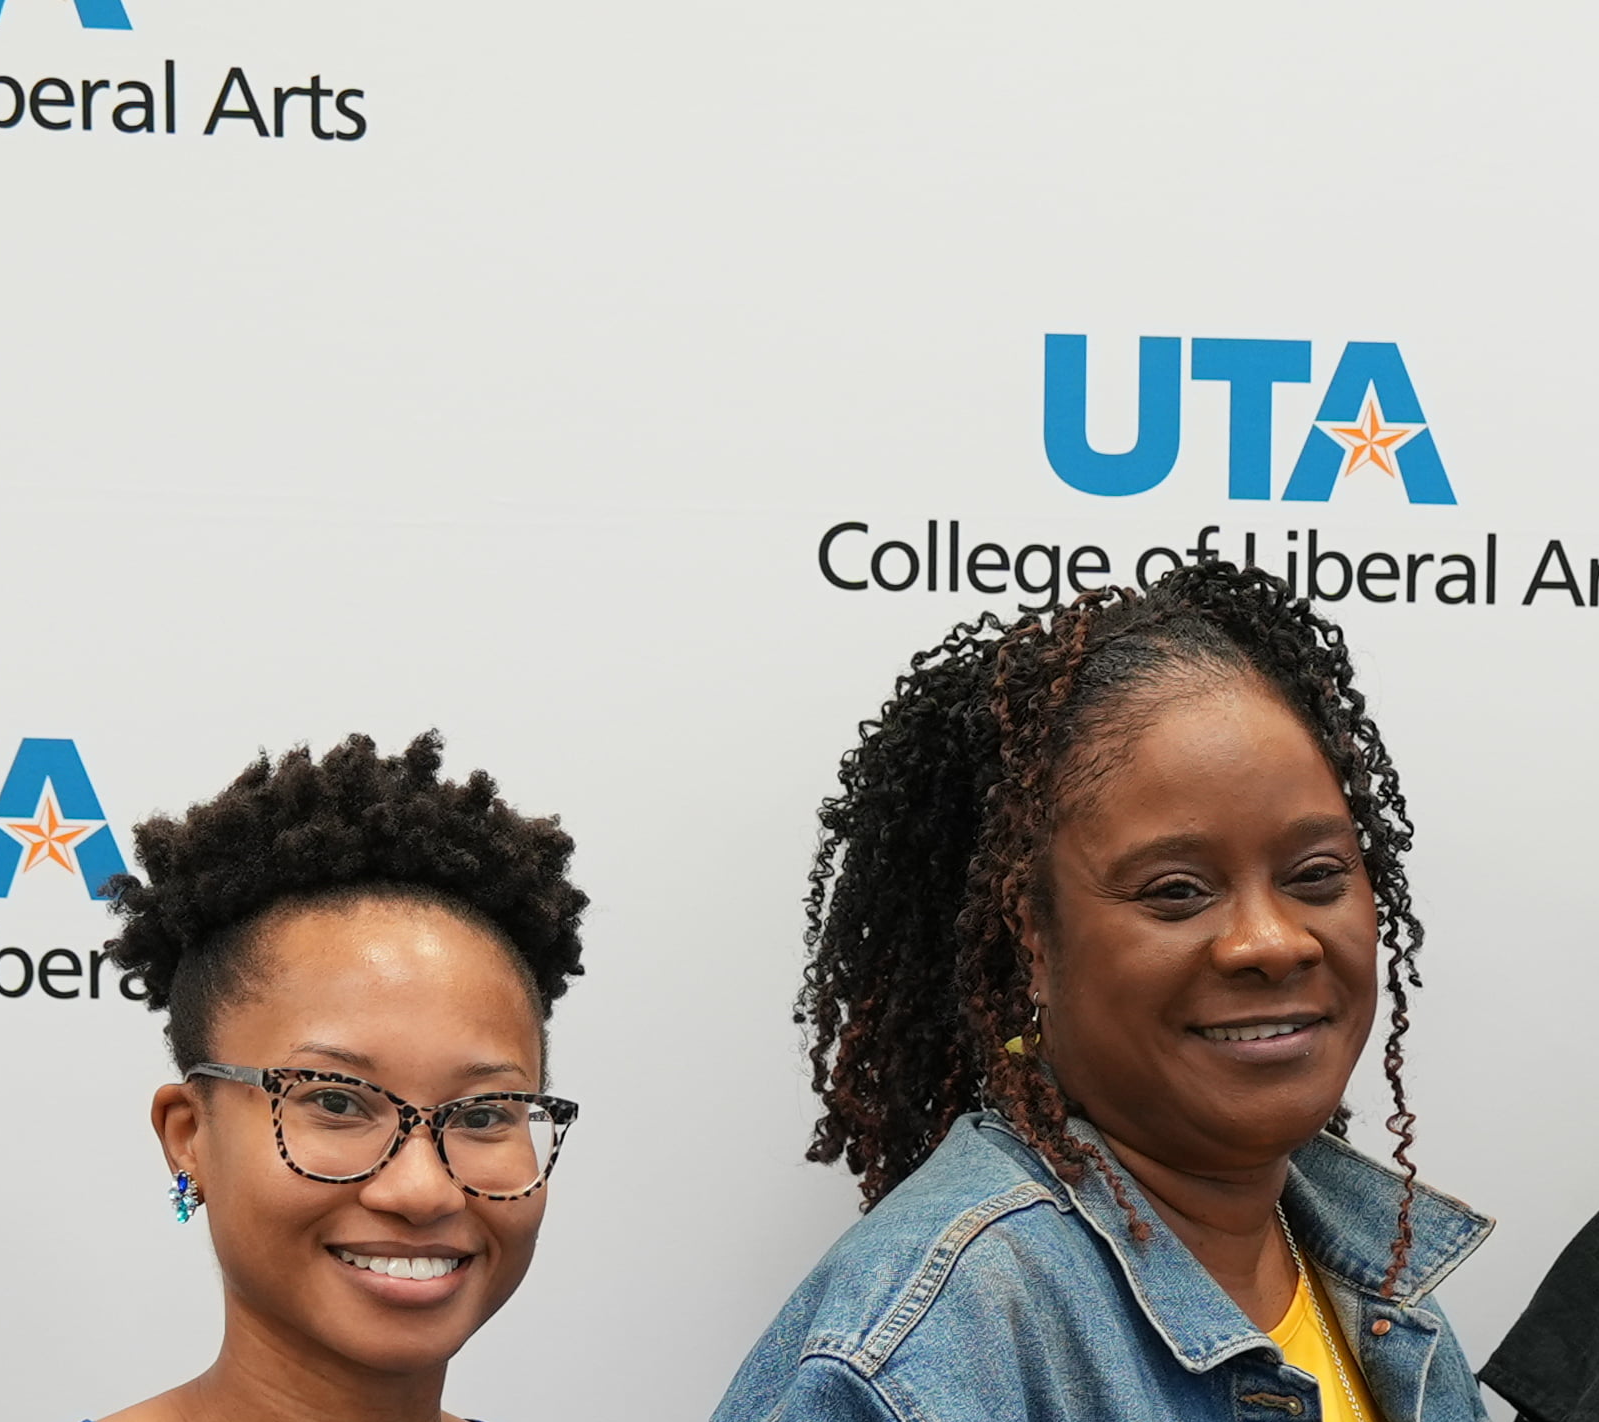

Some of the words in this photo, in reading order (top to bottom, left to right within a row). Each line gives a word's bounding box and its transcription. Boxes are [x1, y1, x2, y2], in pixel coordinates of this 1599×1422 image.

[204, 65, 368, 142] Arts
[1043, 333, 1458, 506] UTA
[818, 520, 1112, 613] College
